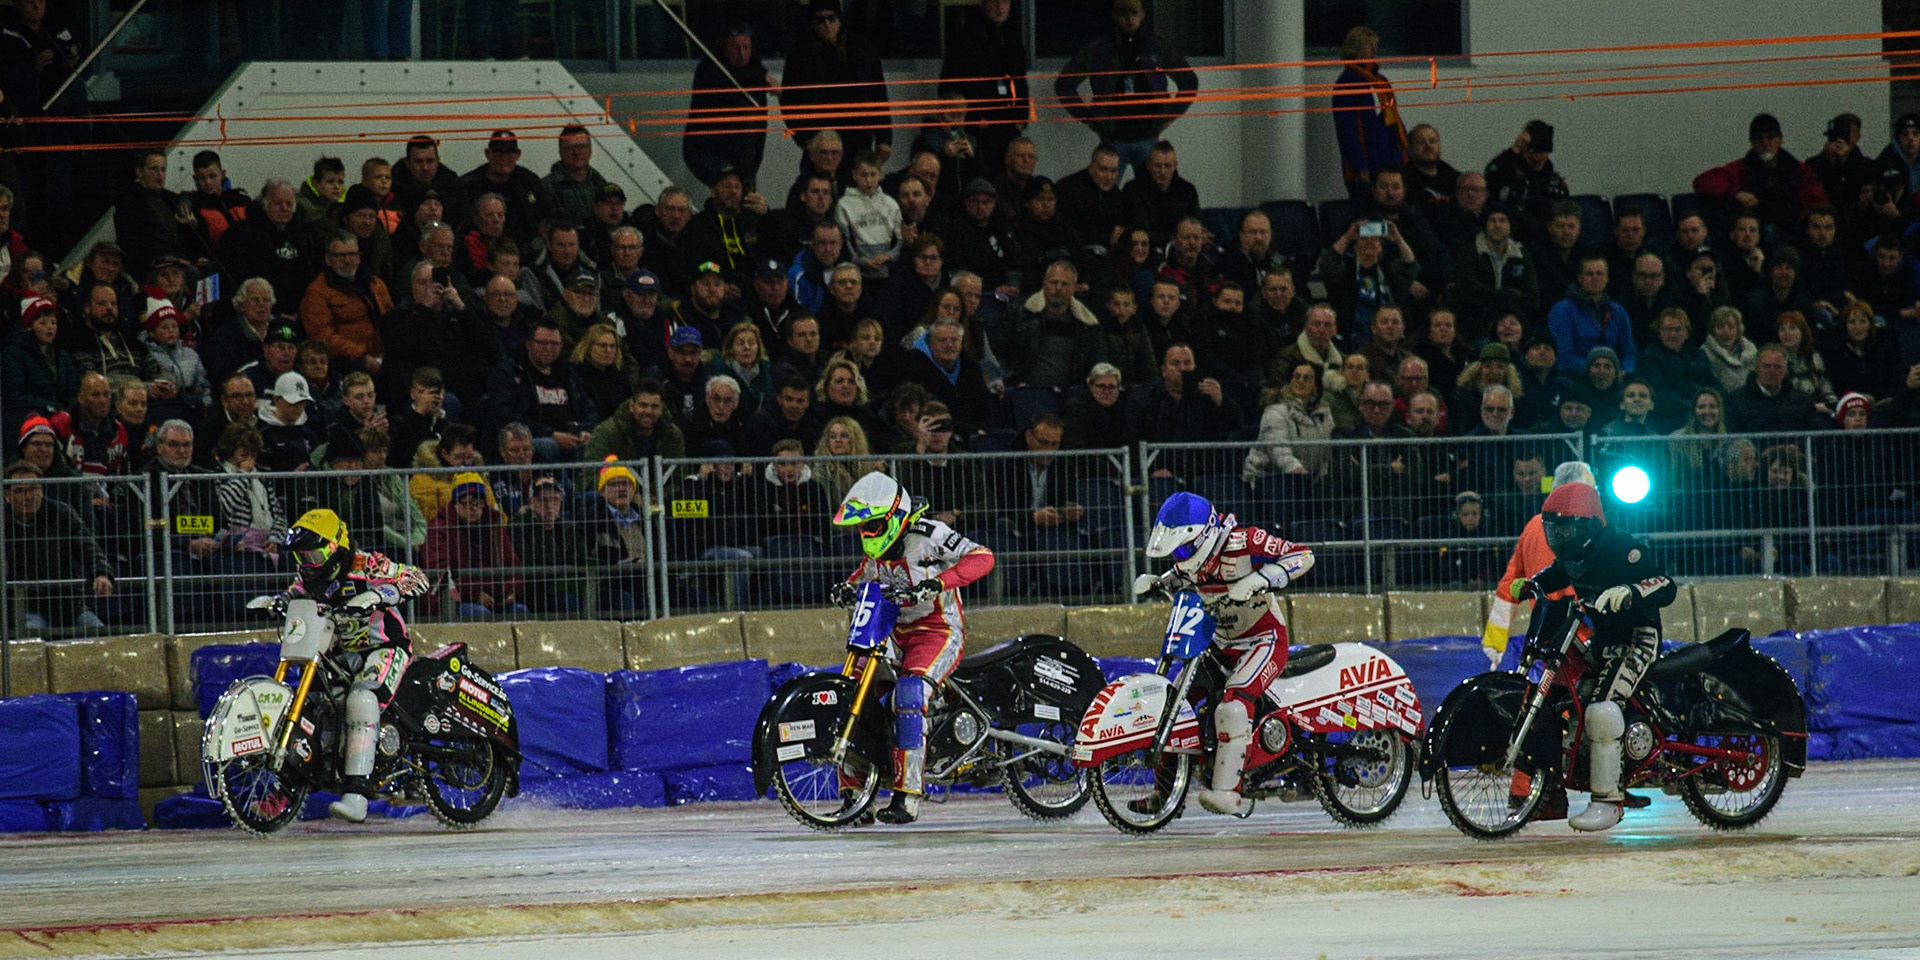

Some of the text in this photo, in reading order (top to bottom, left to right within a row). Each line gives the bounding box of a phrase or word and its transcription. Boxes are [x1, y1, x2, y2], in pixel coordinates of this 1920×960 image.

[675, 502, 704, 512] D.E.V.
[180, 518, 209, 528] D.E.V.
[460, 679, 489, 705] MOTUL
[234, 740, 261, 753] MOTUL
